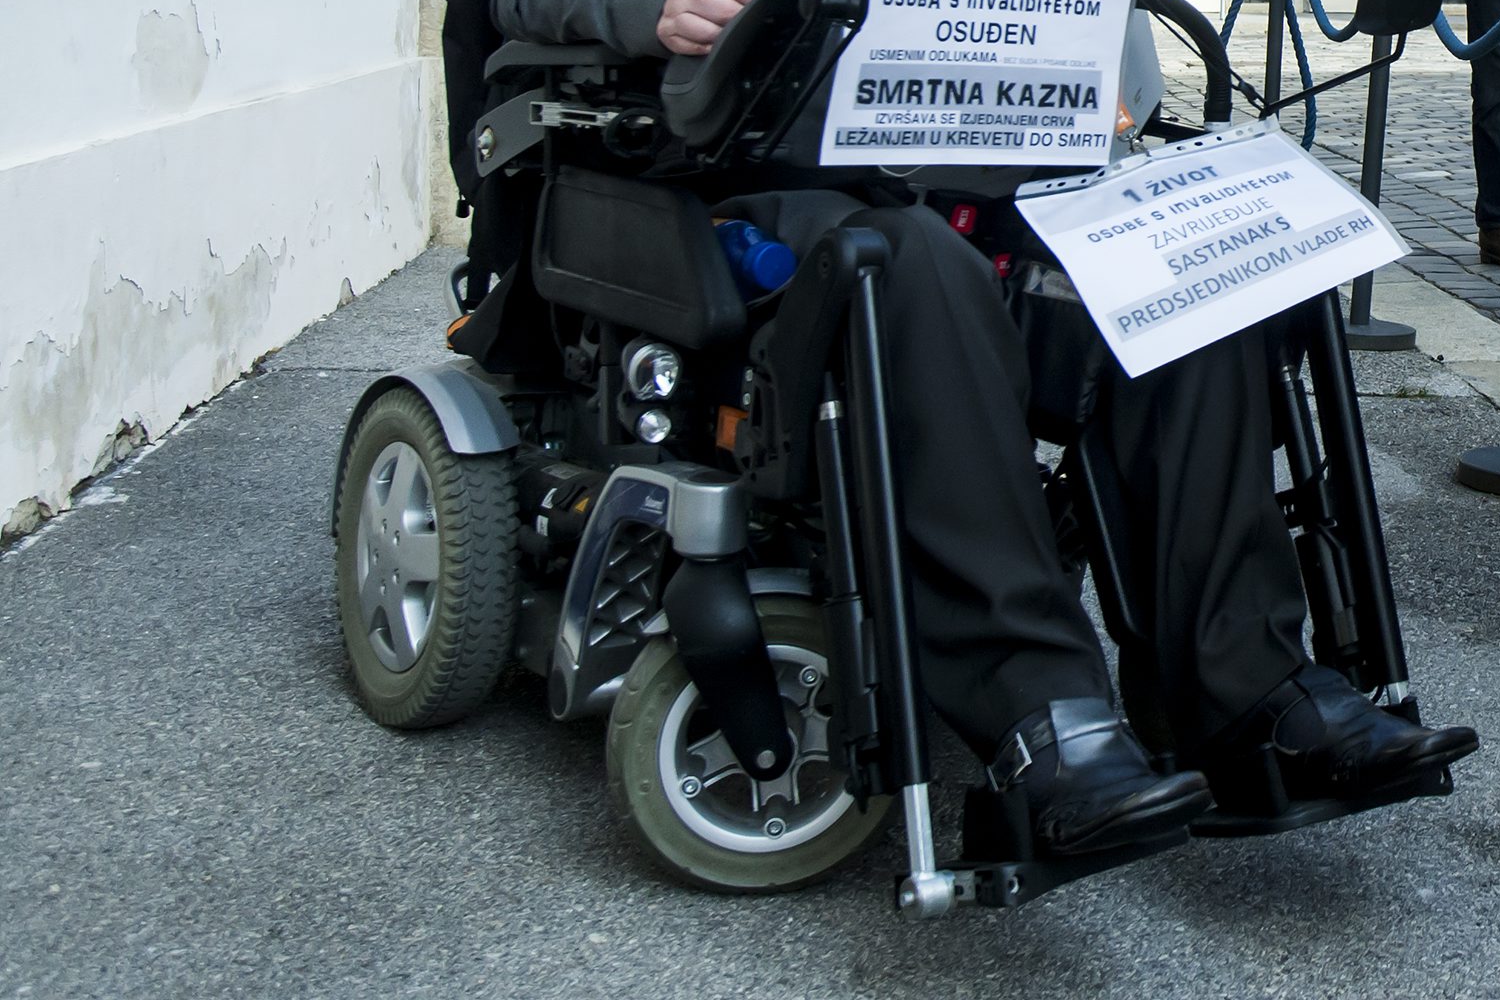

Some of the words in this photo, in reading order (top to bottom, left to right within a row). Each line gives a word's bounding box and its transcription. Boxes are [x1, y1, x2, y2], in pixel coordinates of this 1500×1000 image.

[936, 20, 1037, 45] OSUĐEN
[869, 49, 926, 61] USMENIM
[928, 50, 998, 63] ODLUKAMA
[856, 79, 984, 105] SMRTNA
[996, 80, 1098, 109] KAZNA
[875, 110, 937, 124] IZVRŠAVA
[940, 113, 956, 124] SE
[959, 113, 1038, 126] IZJEDANJEM
[1041, 115, 1075, 127] CRVA
[835, 127, 925, 146] LEŽANJEM
[930, 131, 942, 145] U
[946, 131, 1025, 146] KREVETU
[1029, 133, 1053, 147] DO
[1057, 133, 1107, 148] SMRTI
[1122, 188, 1143, 203] 1
[1145, 165, 1219, 198] ŽIVOT
[1087, 217, 1147, 243] OSOBE
[1150, 210, 1165, 221] S
[1147, 196, 1274, 250] ZAVRIJEĐUJE
[1168, 221, 1277, 276] SASTANAK
[1275, 215, 1291, 231] S
[1117, 246, 1293, 334] PREDSJEDNIKOM
[1293, 228, 1350, 256] VLADE
[1348, 215, 1375, 240] RH
